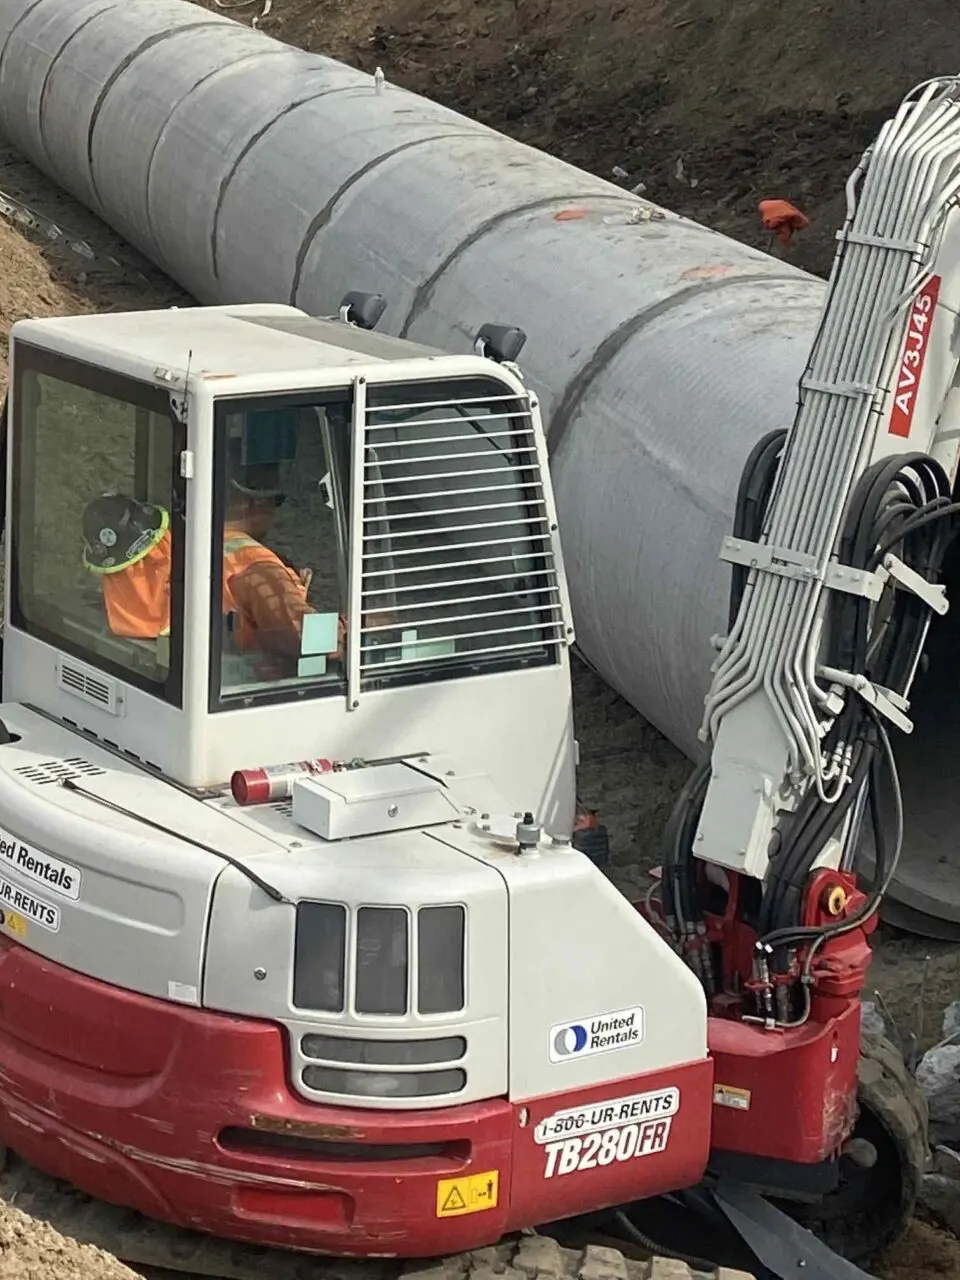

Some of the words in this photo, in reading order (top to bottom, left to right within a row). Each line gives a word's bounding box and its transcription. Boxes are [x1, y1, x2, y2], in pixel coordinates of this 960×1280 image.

[895, 294, 932, 416] AV3J45
[17, 846, 73, 890] Rentals
[590, 1013, 635, 1035] United
[590, 1027, 639, 1050] Rentals
